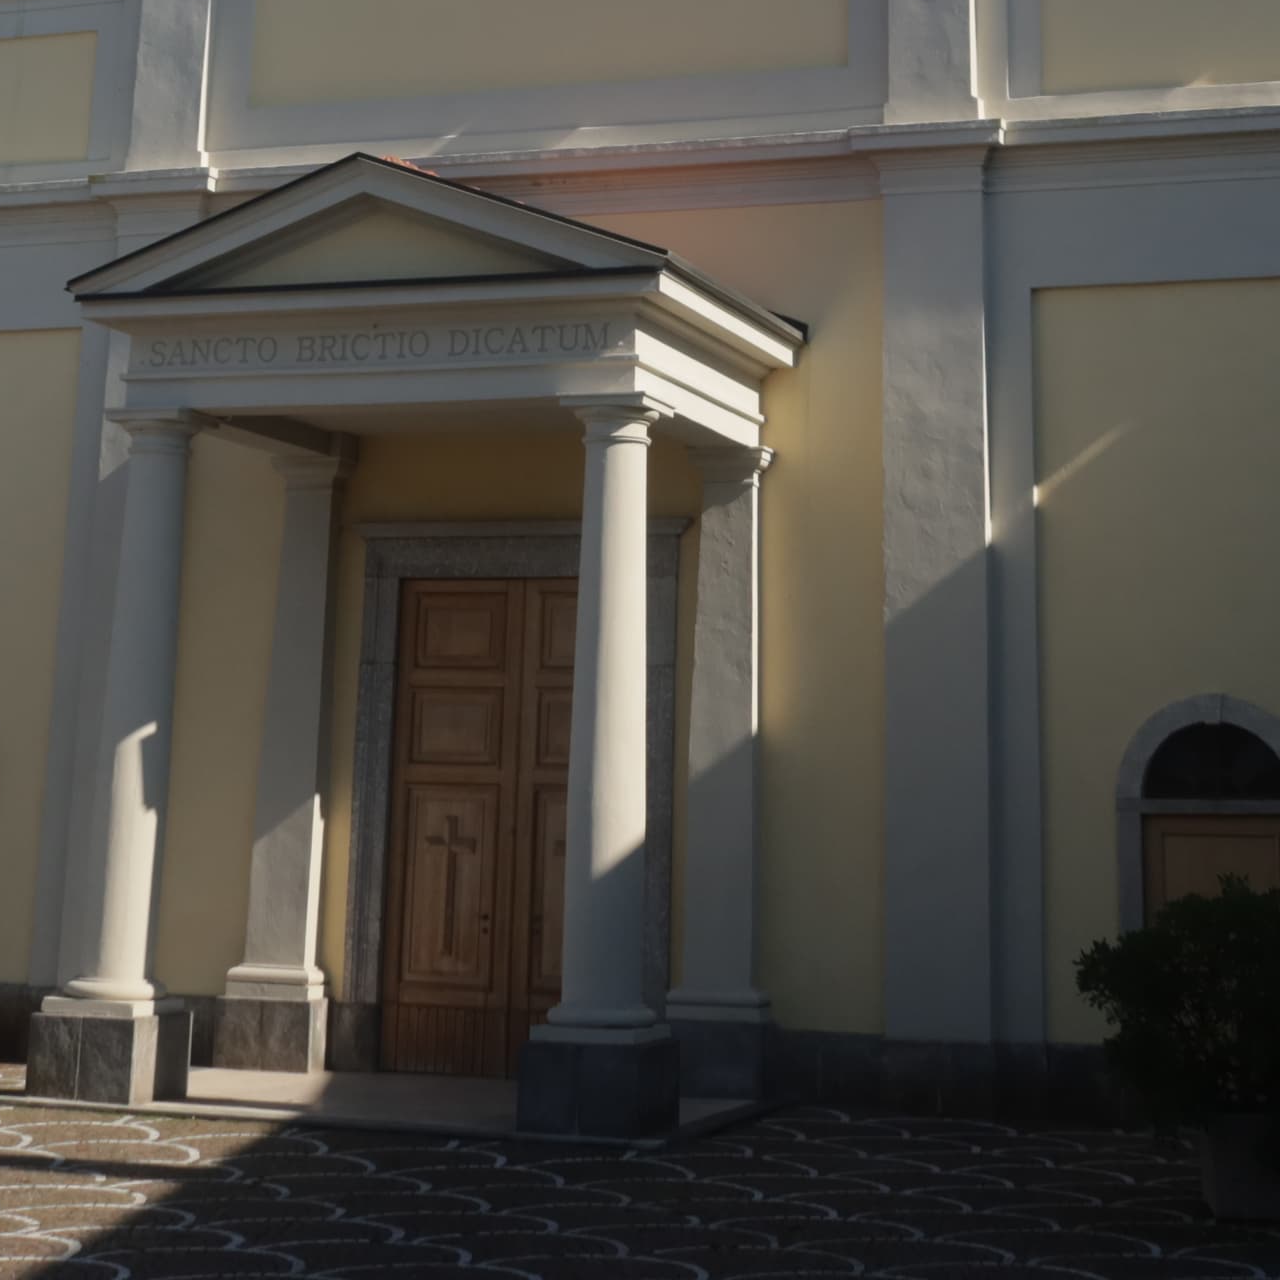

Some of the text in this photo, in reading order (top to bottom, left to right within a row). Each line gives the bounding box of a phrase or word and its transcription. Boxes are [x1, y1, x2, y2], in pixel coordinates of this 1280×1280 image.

[150, 322, 611, 368] SANCTO BRICTIO DICATUM
